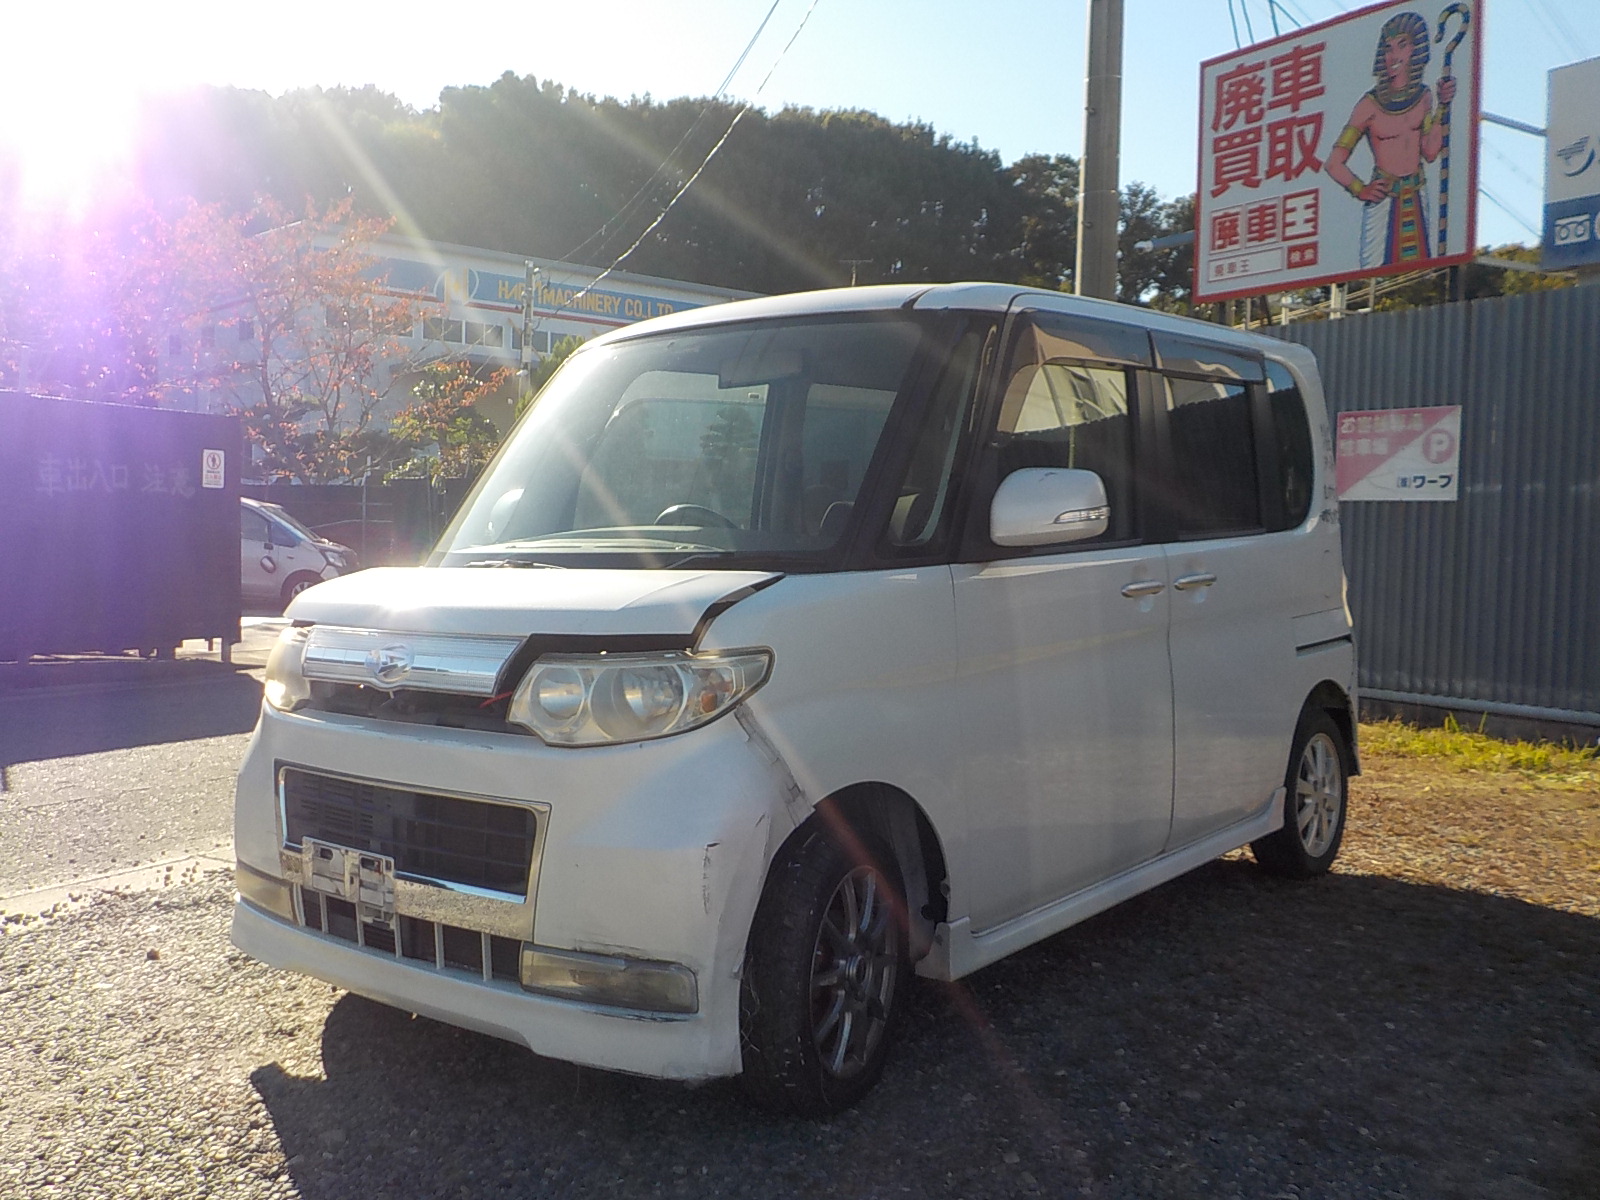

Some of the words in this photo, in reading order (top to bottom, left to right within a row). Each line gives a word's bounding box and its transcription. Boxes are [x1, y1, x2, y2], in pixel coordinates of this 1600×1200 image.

[1212, 42, 1326, 131] 廃車
[1210, 111, 1325, 198] 買取
[543, 286, 621, 315] MACHINERY
[35, 451, 128, 497] 車出入口
